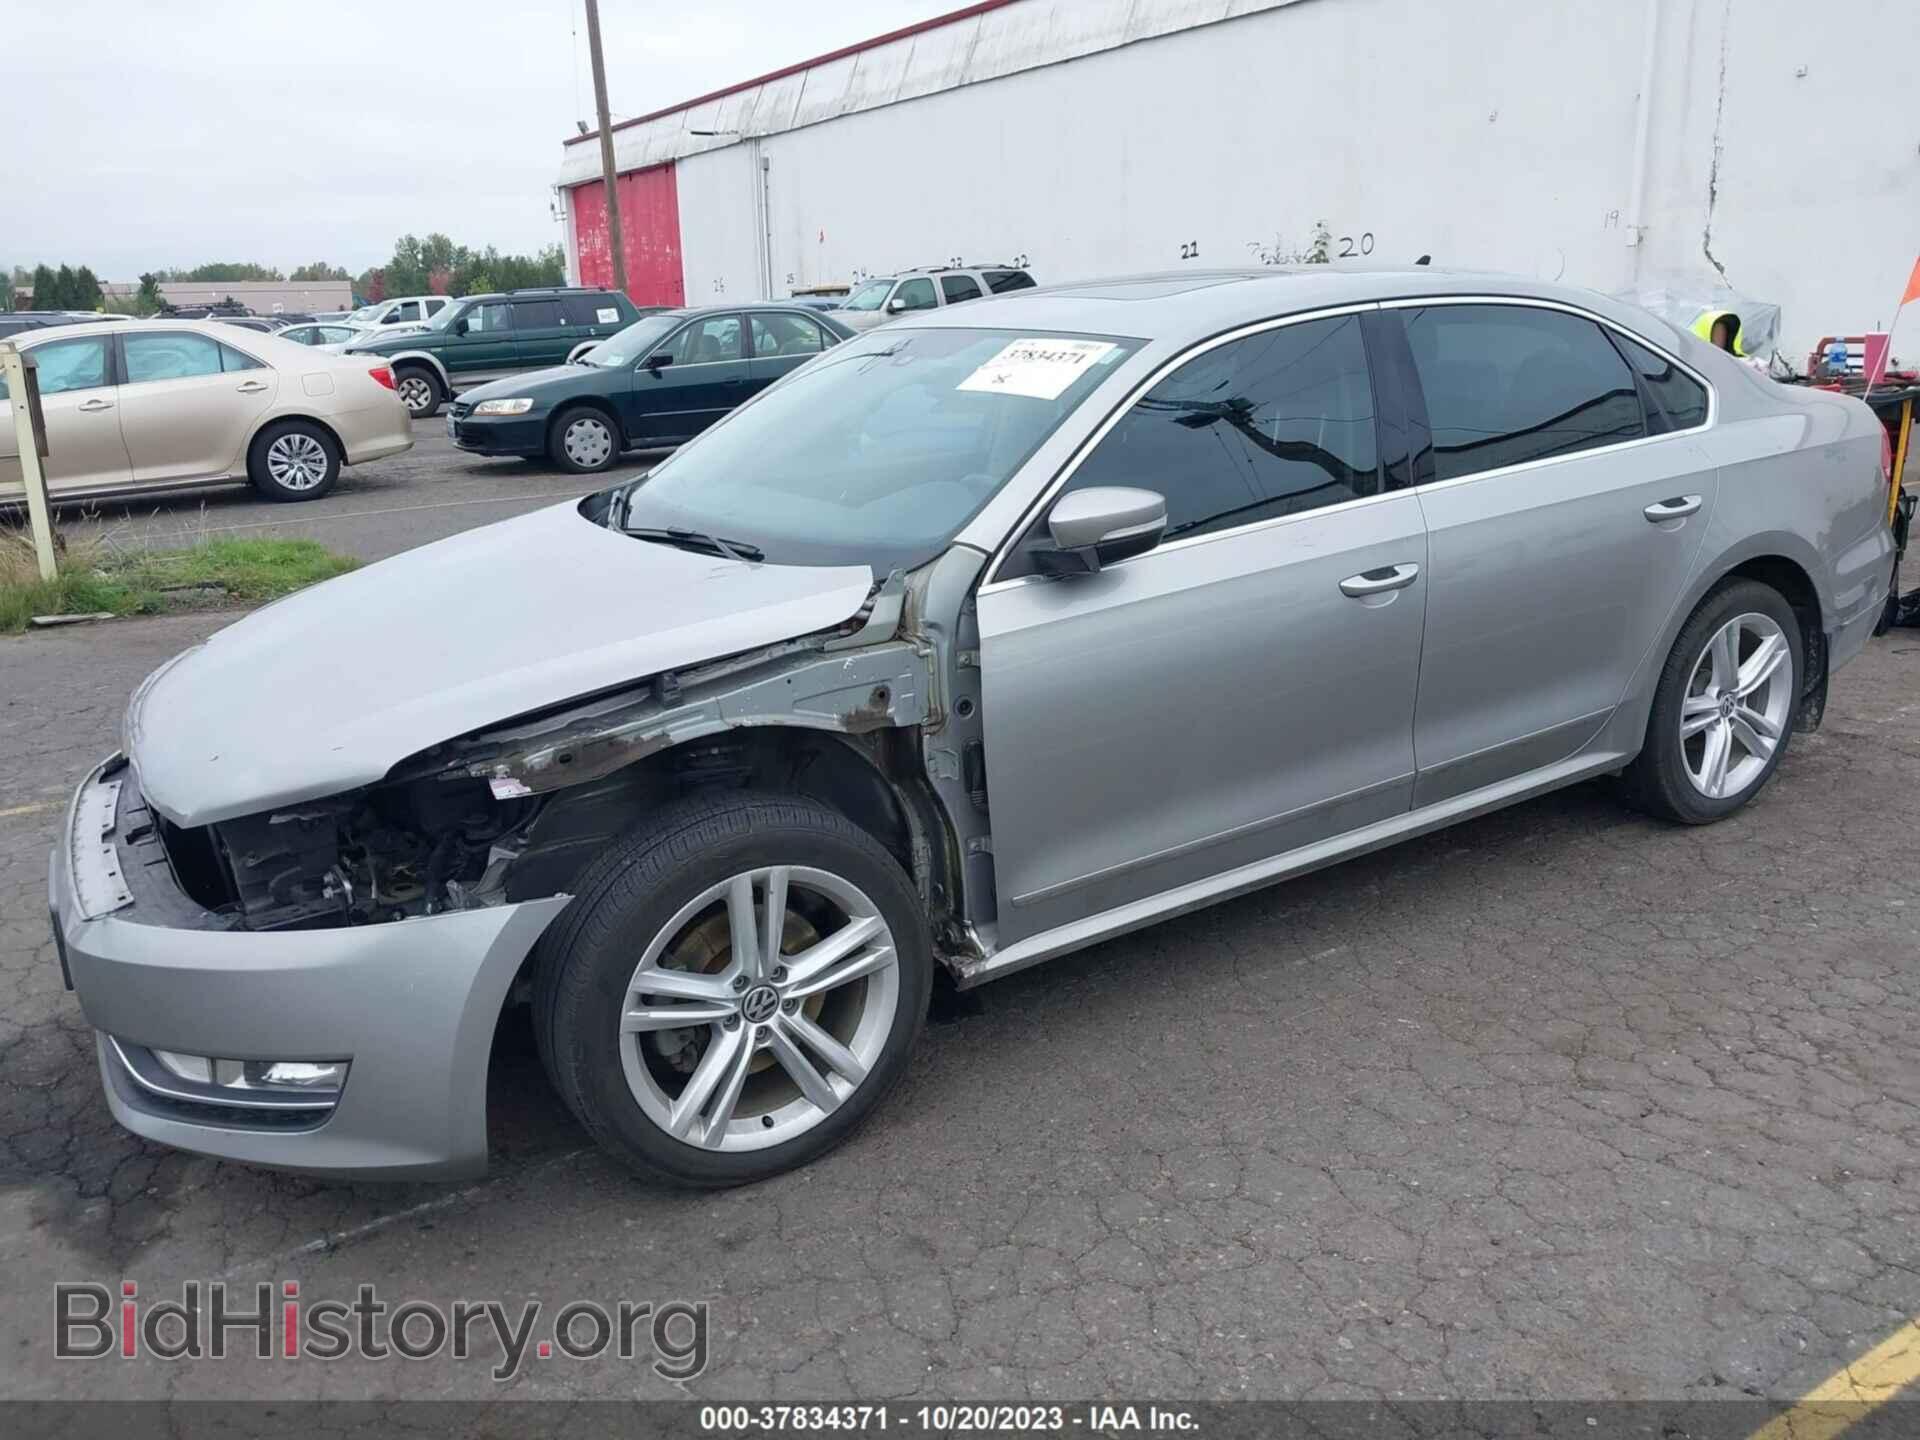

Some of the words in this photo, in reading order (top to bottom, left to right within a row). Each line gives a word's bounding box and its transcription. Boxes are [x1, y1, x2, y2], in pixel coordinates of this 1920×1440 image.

[1604, 209, 1620, 229] 19
[1180, 240, 1199, 259] 21
[1338, 232, 1375, 258] 20
